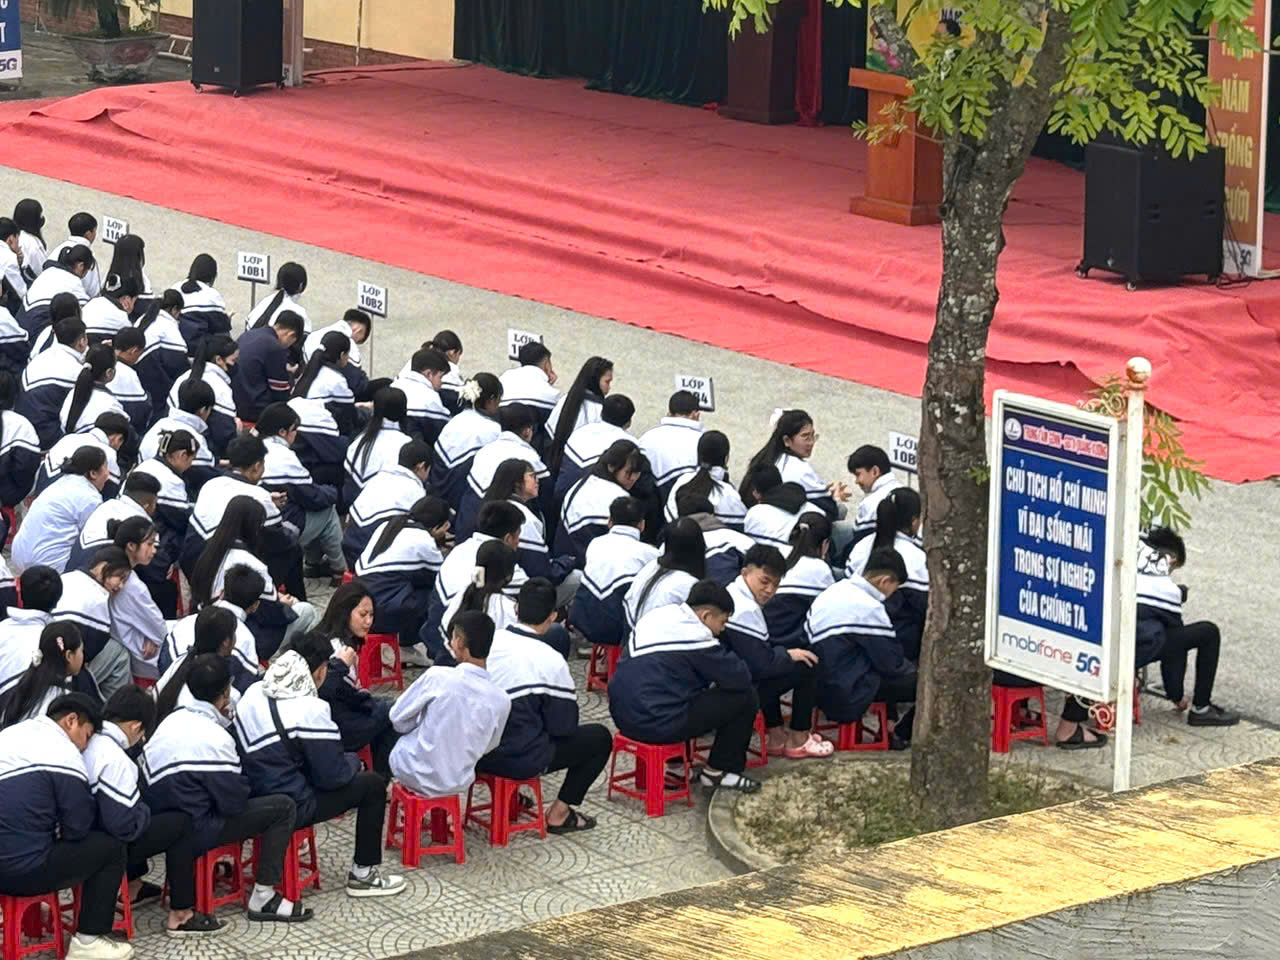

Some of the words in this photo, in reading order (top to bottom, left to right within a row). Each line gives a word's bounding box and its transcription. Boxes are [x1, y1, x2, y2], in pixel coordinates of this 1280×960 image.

[107, 229, 124, 240] 11A
[243, 255, 263, 265] LỚP
[242, 265, 264, 278] 10B1
[361, 294, 383, 311] 10B2
[681, 377, 705, 390] LỚP
[893, 449, 916, 466] 10B
[1006, 459, 1025, 494] CHỦ
[1027, 471, 1048, 503] TỊCH
[1064, 479, 1080, 509] CHÍ
[1081, 486, 1106, 516] MINH
[1029, 511, 1045, 543] ĐẠI
[1046, 510, 1072, 547] SỐNG
[1073, 522, 1093, 553] MÃI
[1014, 547, 1044, 579] TRONG
[1046, 556, 1060, 588] SỰ
[1061, 560, 1096, 598] NGHIỆP
[1019, 580, 1038, 617] CỦA
[1040, 593, 1072, 627] CHÚNG
[1073, 604, 1088, 632] TA.
[1002, 632, 1072, 664] mobifone
[1075, 651, 1101, 677] 5G
